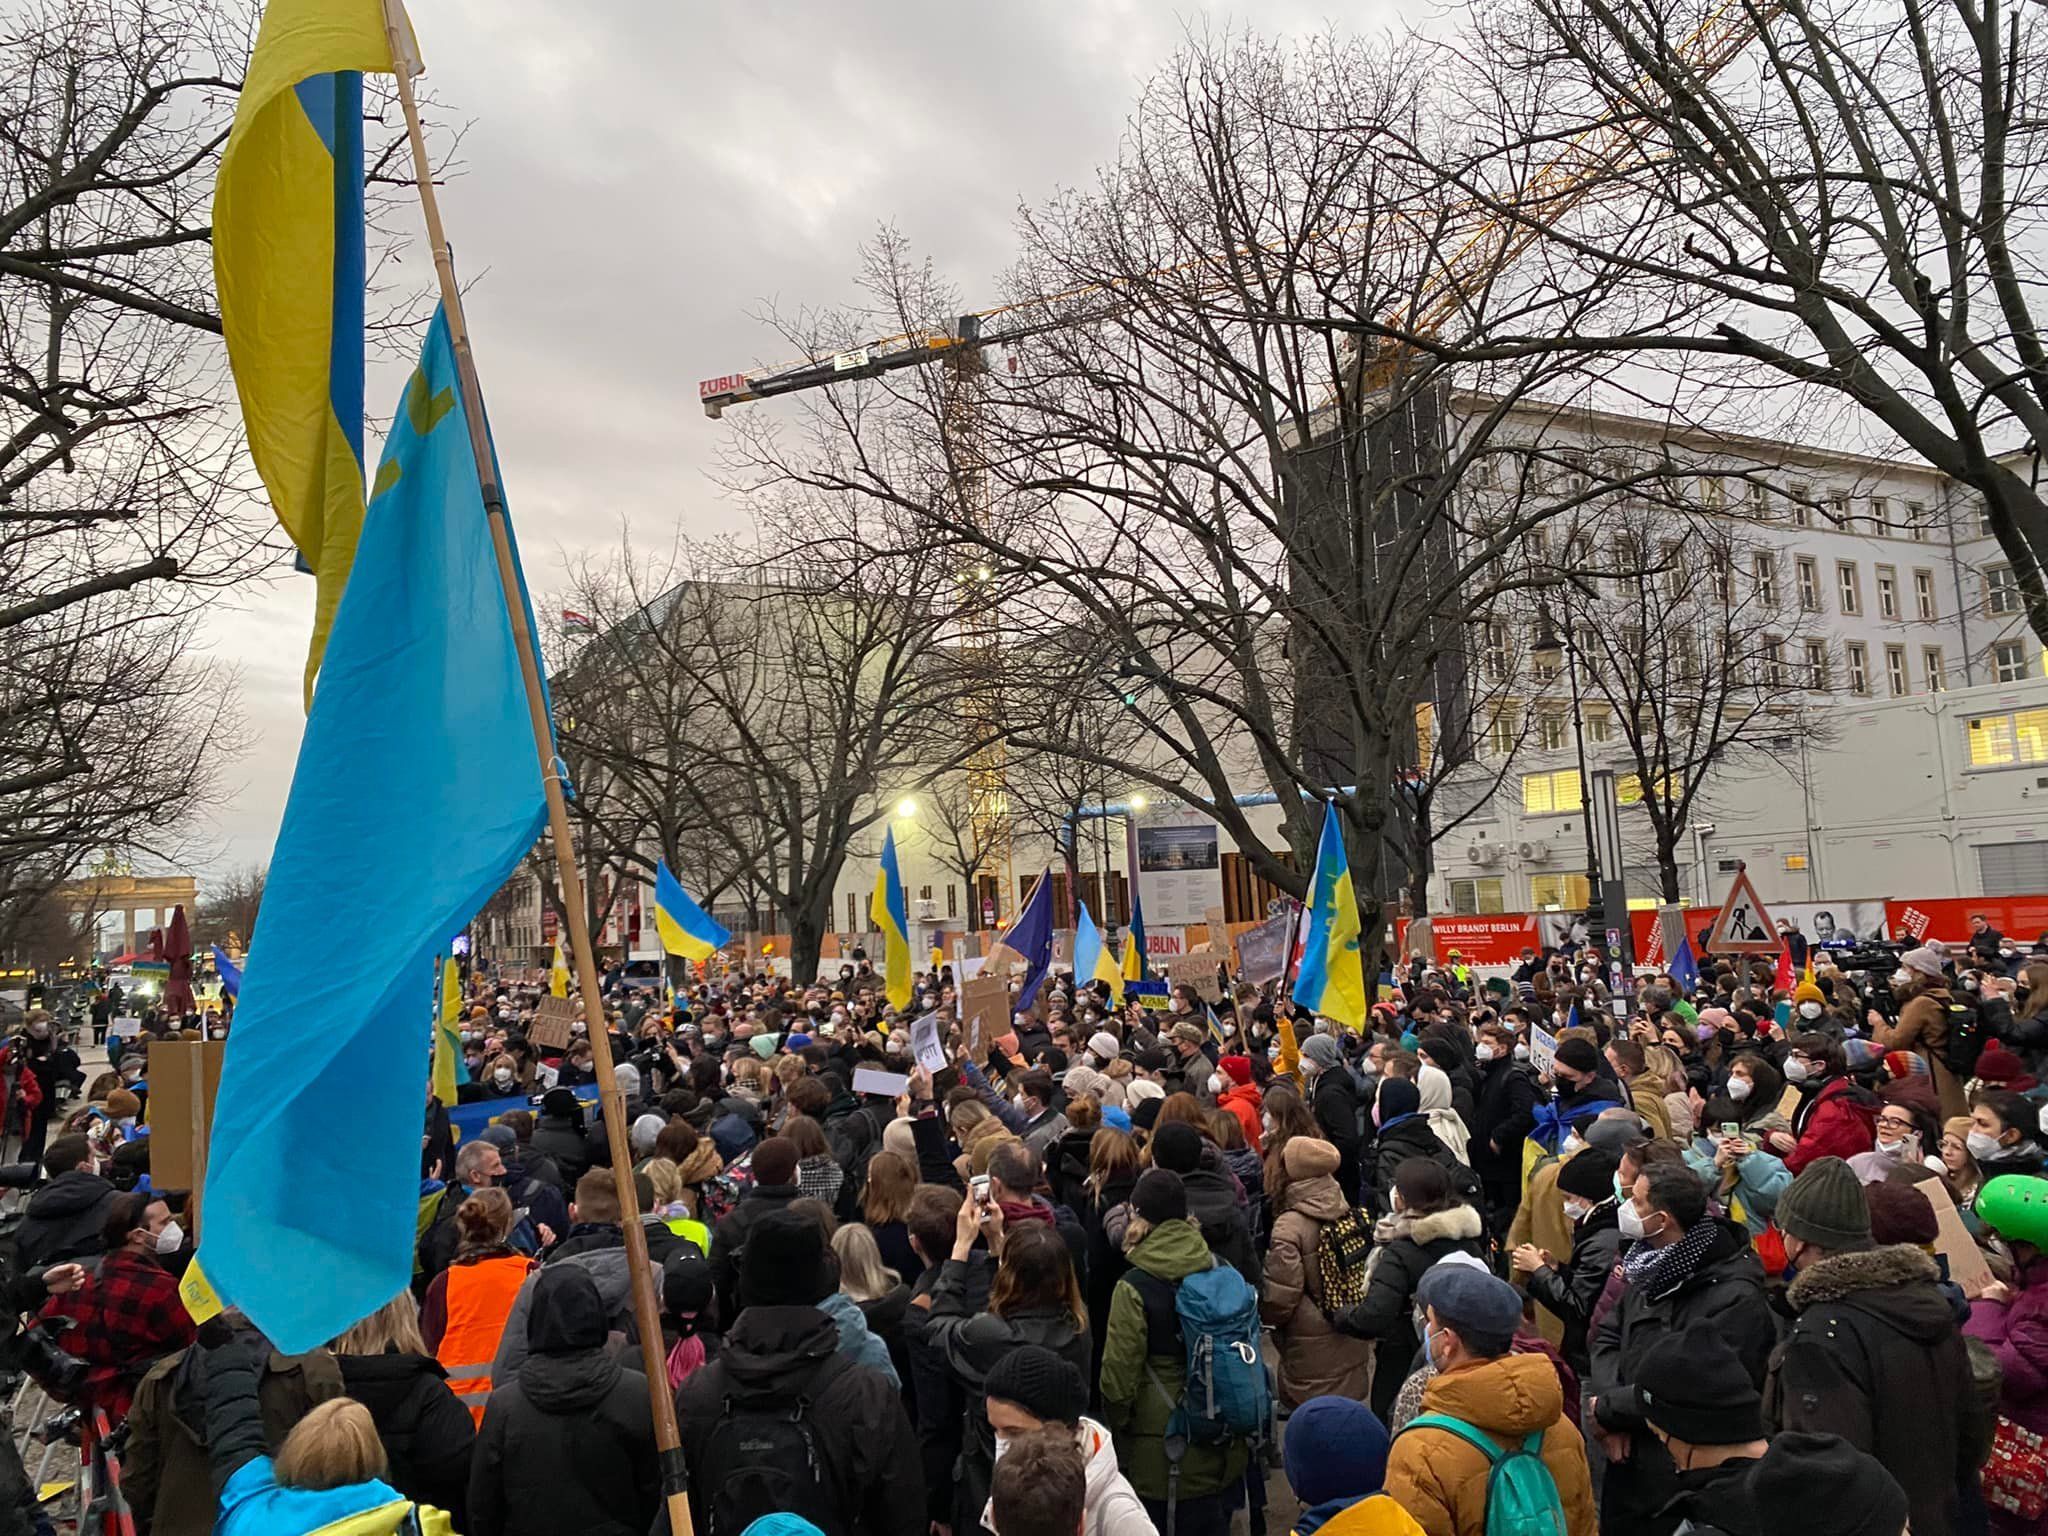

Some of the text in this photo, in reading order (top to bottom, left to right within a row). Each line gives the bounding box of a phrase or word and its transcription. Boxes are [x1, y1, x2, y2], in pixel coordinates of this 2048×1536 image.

[1432, 923, 1520, 934] WILLY BRANDT BERLIN
